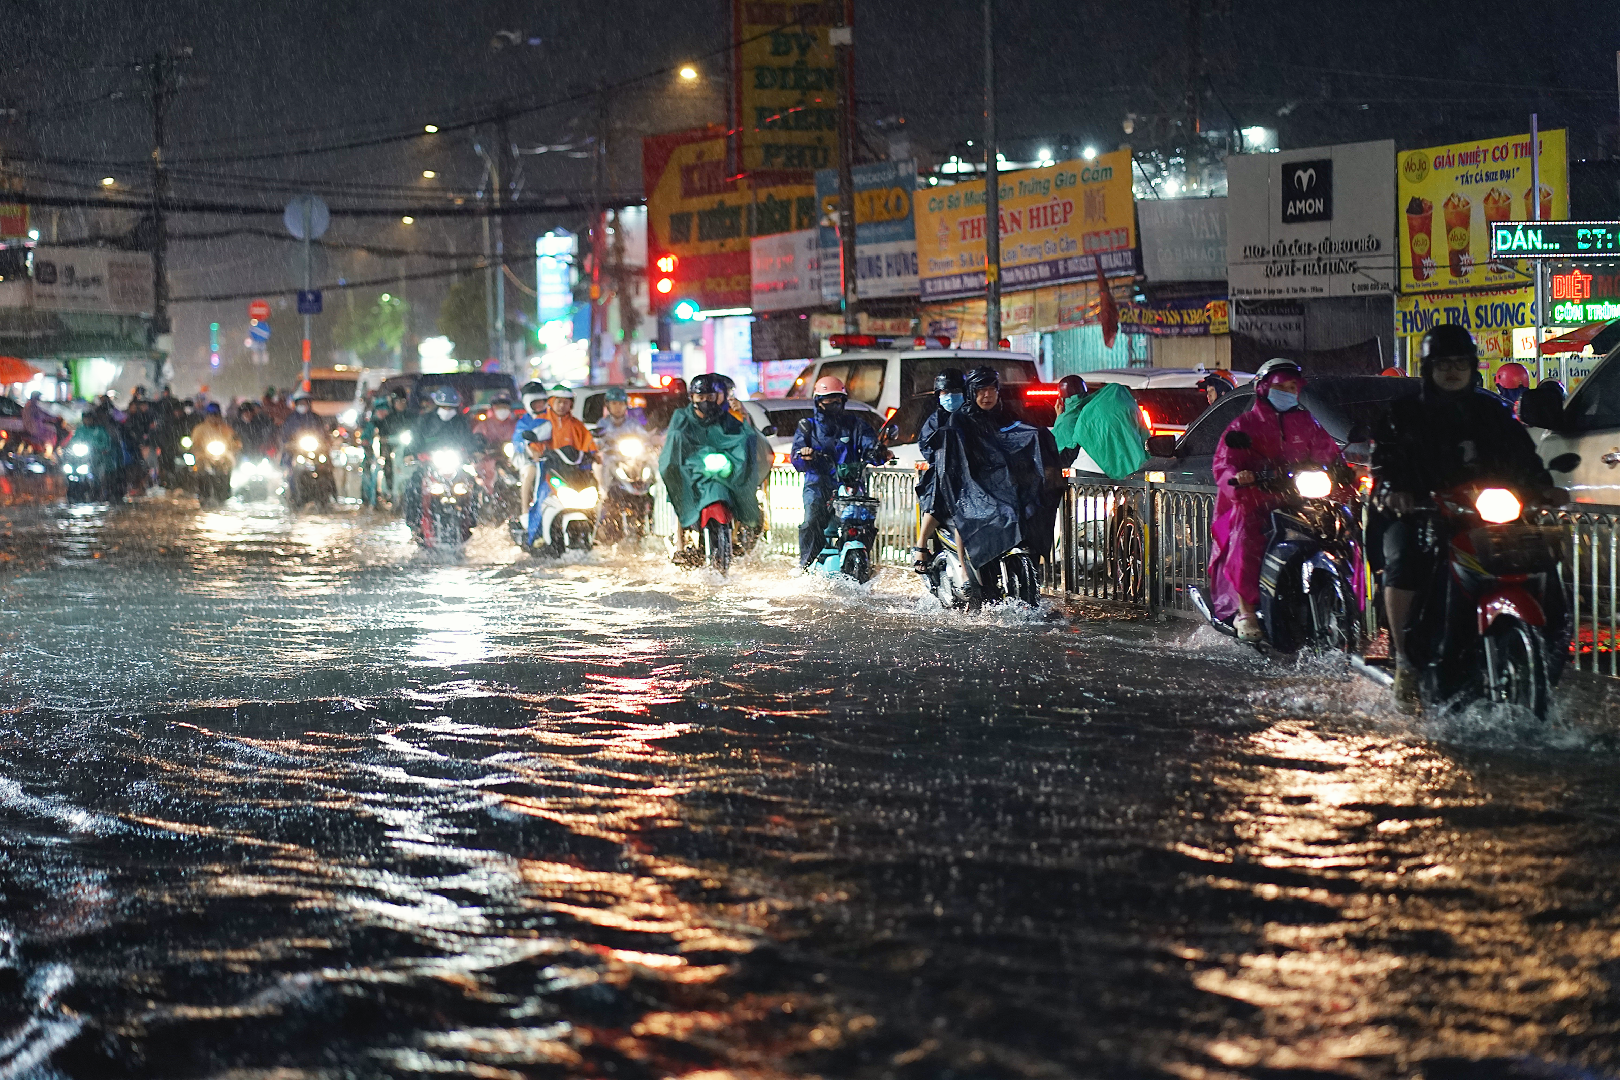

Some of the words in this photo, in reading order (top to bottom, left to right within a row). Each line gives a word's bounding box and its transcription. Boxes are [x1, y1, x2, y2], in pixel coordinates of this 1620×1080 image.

[1433, 150, 1455, 170] GIẢI
[1457, 146, 1489, 169] NHIỆT
[1491, 142, 1509, 163] CƠ
[998, 183, 1014, 199] án
[1054, 172, 1077, 189] Gia
[1081, 161, 1113, 184] Cầm
[1028, 196, 1075, 232] HIỆP
[1287, 198, 1324, 216] AMON
[1553, 269, 1593, 304] DIỆT
[1402, 300, 1441, 333] HỒNG
[1443, 300, 1472, 330] TRÀ
[1474, 301, 1526, 329] SƯƠNG
[1486, 336, 1502, 353] 15K
